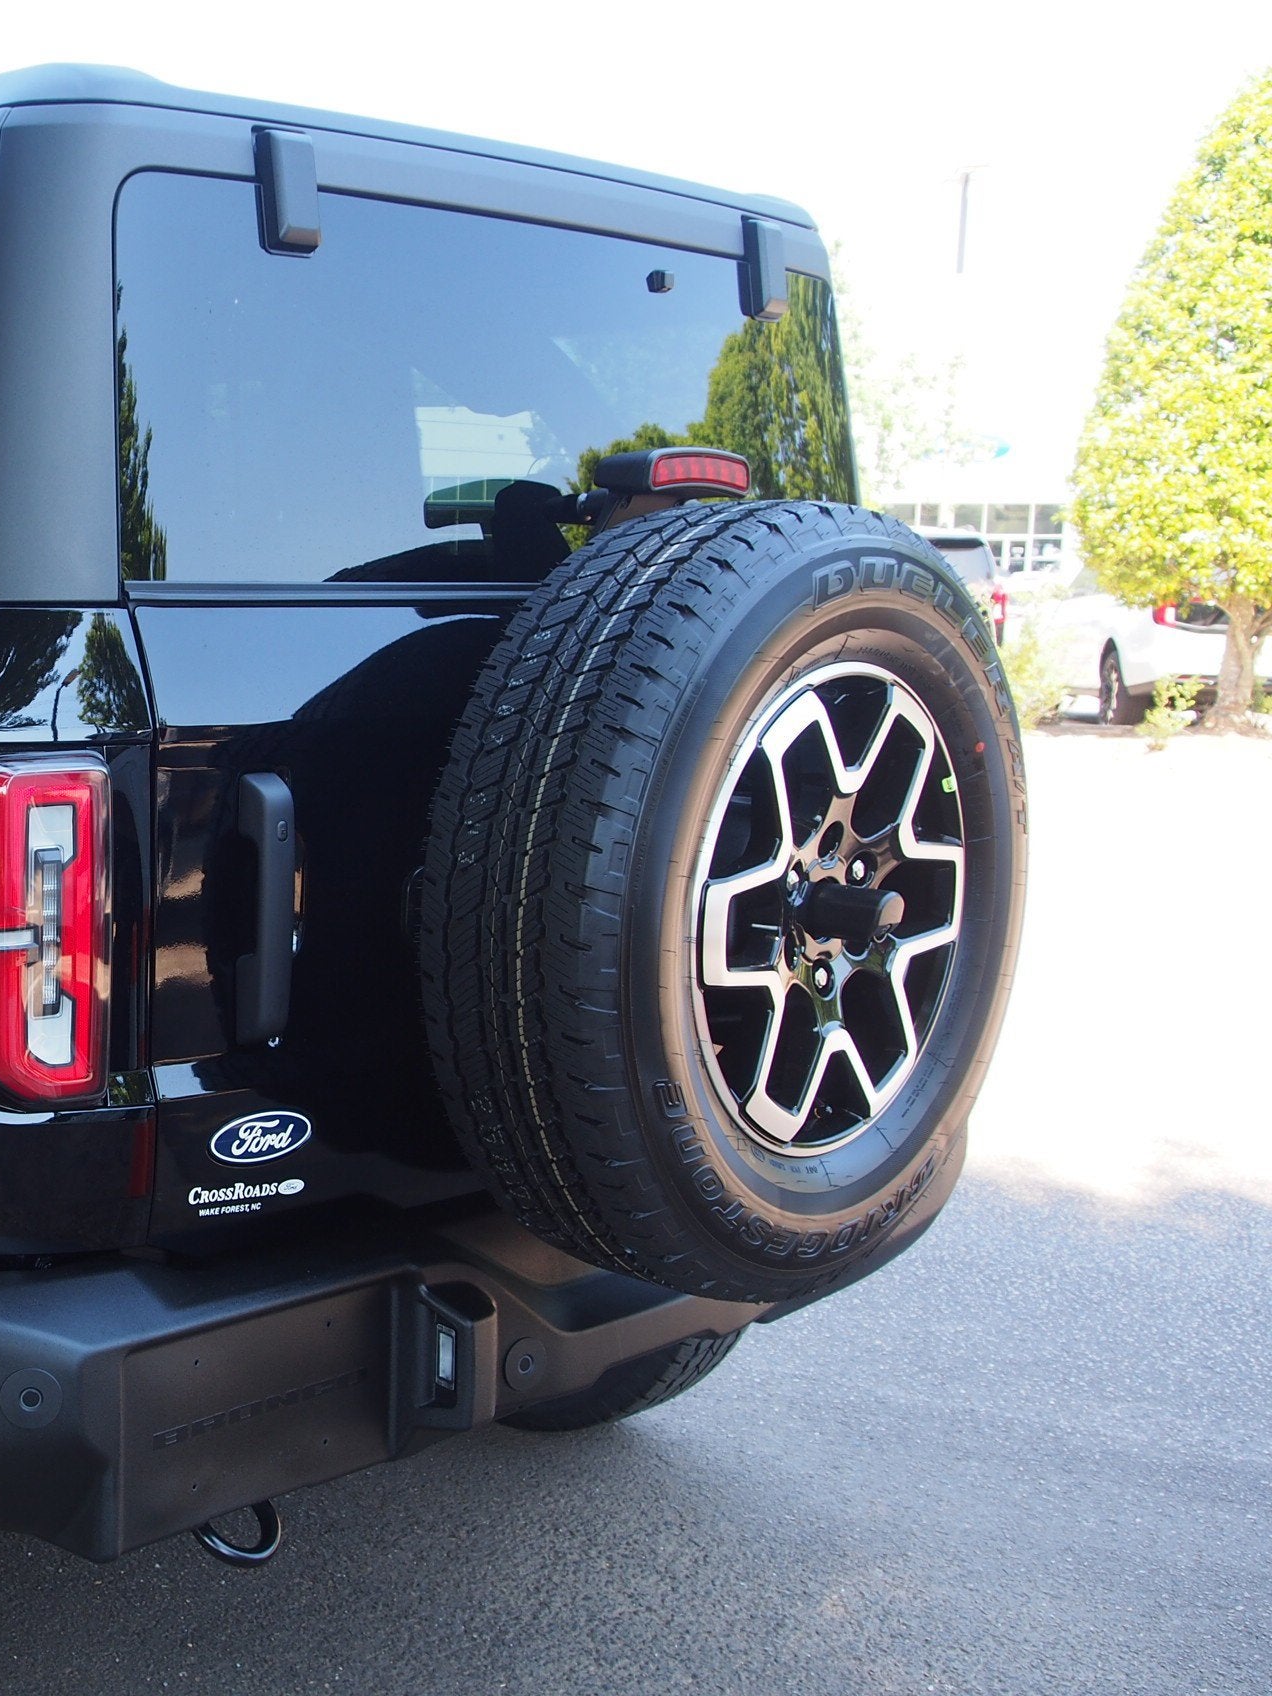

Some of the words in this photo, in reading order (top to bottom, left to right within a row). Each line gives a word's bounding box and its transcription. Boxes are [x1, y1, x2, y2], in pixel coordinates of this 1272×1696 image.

[812, 556, 1011, 717] DUELER
[231, 1119, 295, 1156] Ford
[198, 1206, 220, 1217] WAKE
[220, 1203, 250, 1214] FOREST,
[250, 1202, 262, 1211] NC
